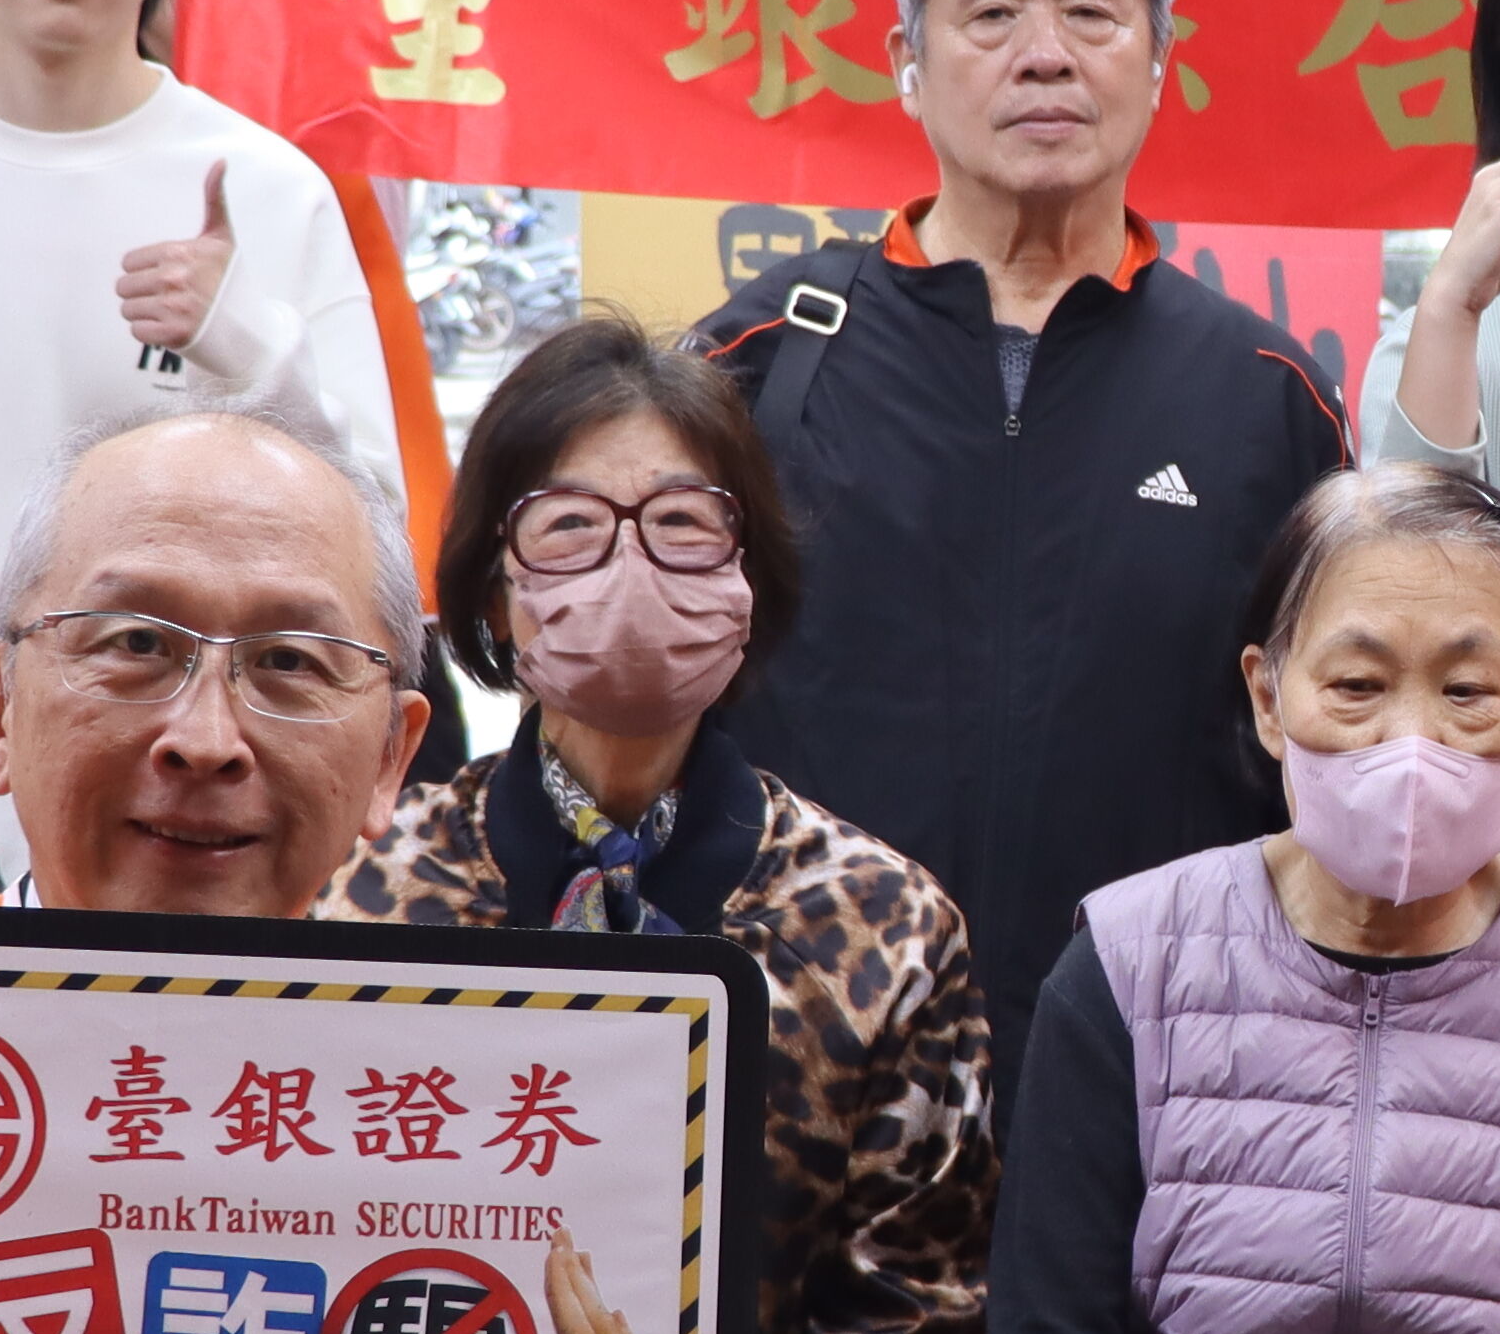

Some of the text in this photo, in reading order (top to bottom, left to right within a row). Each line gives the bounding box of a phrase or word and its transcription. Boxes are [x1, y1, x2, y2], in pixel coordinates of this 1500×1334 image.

[1137, 485, 1198, 507] adidas
[84, 1045, 601, 1178] 臺銀證券
[98, 1193, 565, 1244] BankTaiwan SECURITIES
